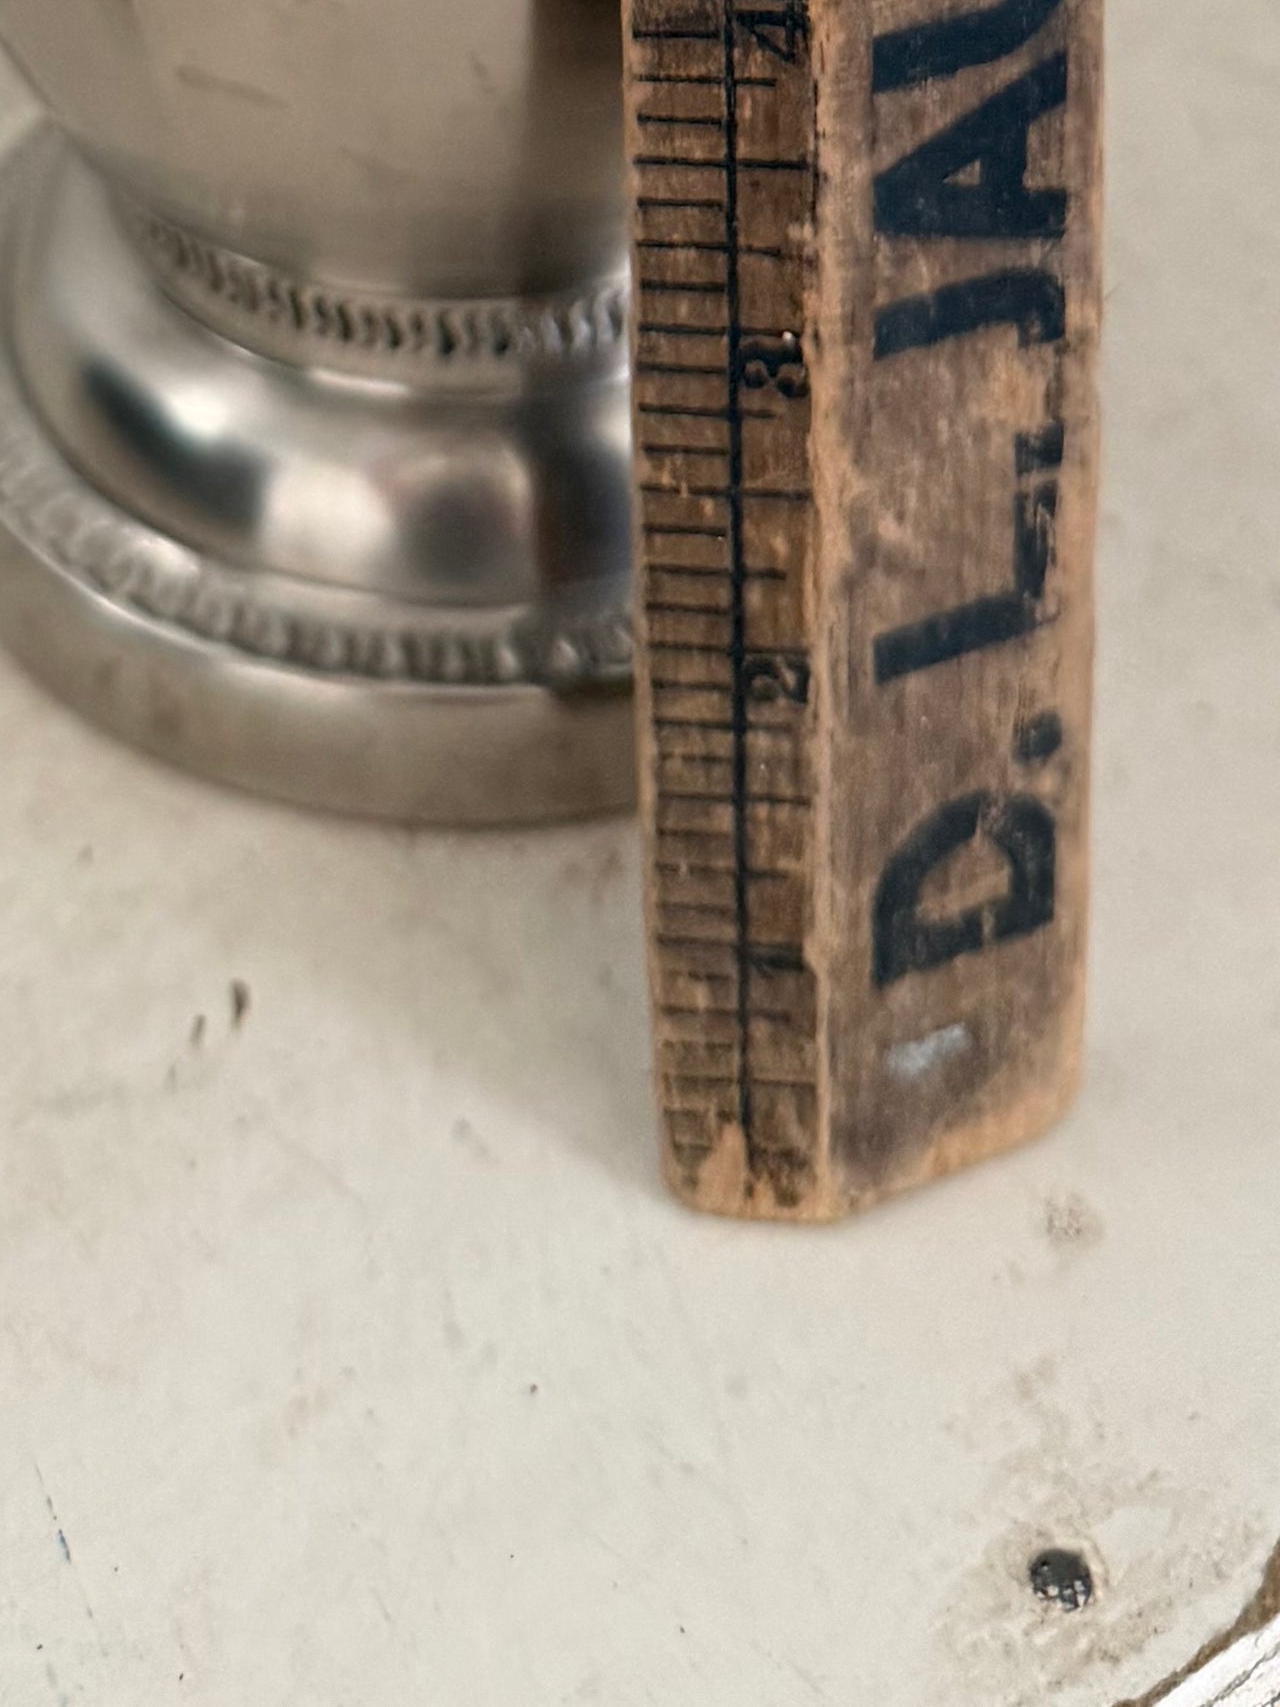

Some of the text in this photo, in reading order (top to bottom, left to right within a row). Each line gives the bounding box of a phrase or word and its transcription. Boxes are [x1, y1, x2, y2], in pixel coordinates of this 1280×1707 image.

[734, 5, 808, 64] 4
[744, 655, 812, 707] 2
[869, 707, 1065, 991] D.
